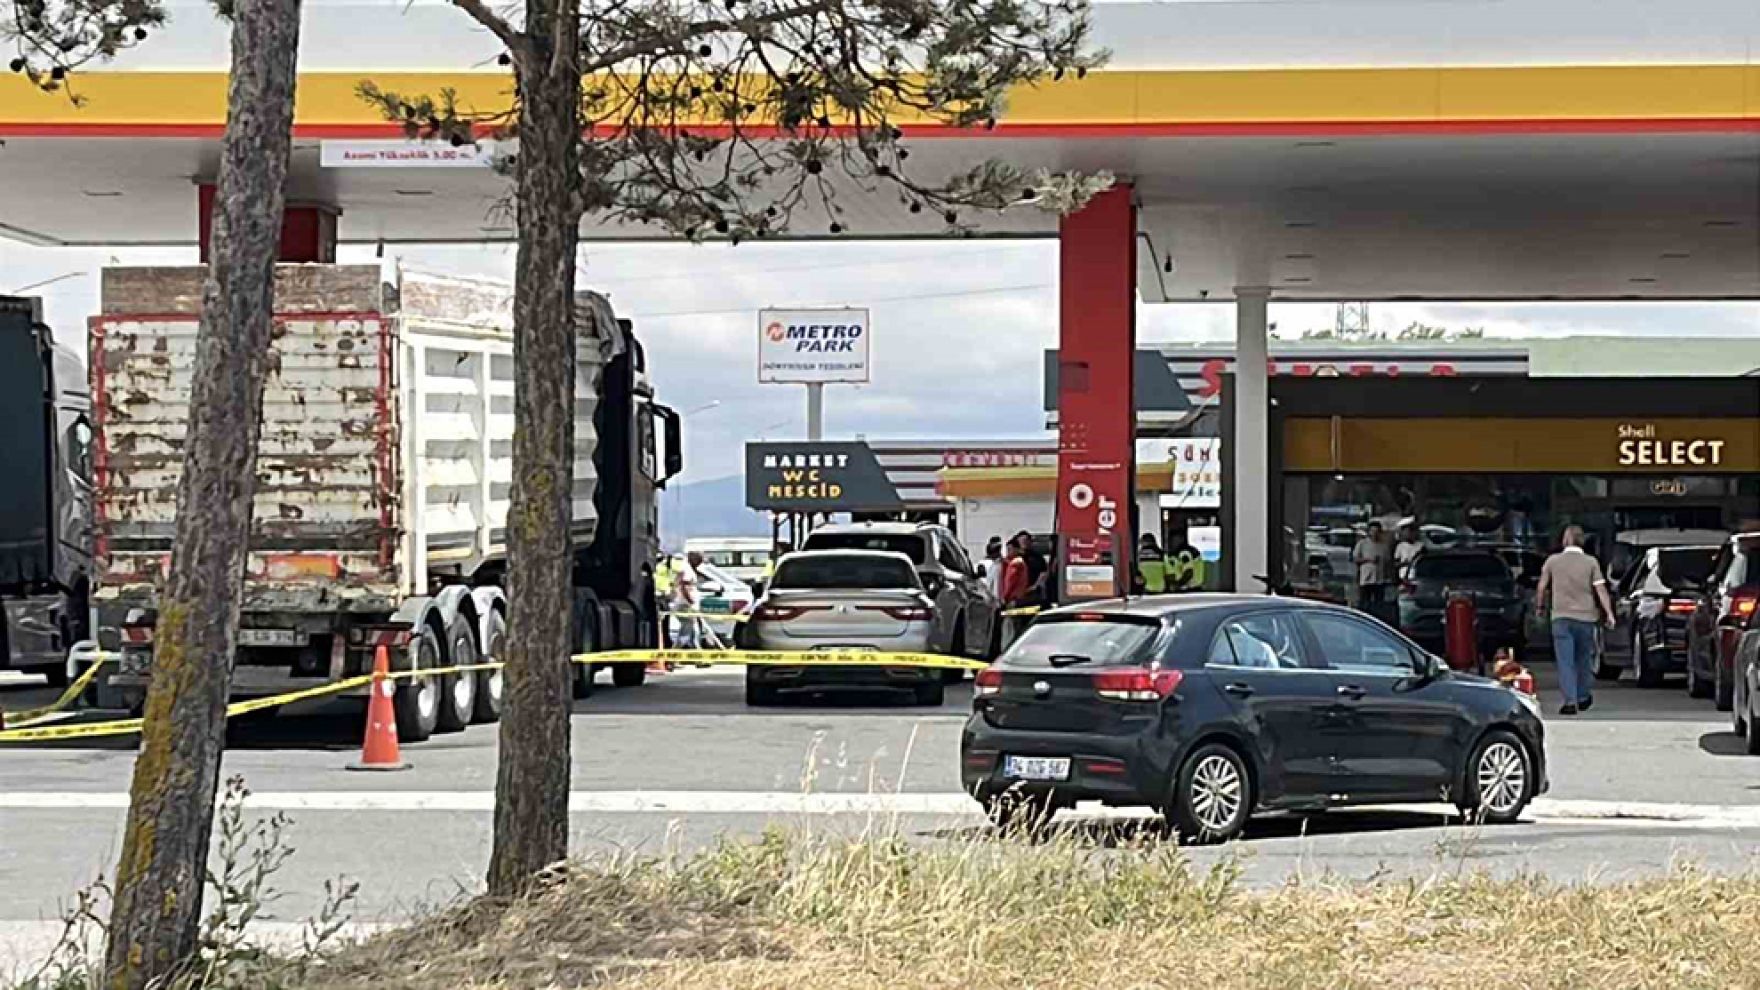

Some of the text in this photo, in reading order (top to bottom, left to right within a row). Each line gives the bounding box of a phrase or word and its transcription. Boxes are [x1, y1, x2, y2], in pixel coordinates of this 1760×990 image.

[786, 324, 863, 339] METRO
[795, 339, 854, 353] PARK
[1618, 424, 1656, 438] Shell
[1618, 440, 1725, 465] SELECT
[763, 454, 849, 468] MARKET
